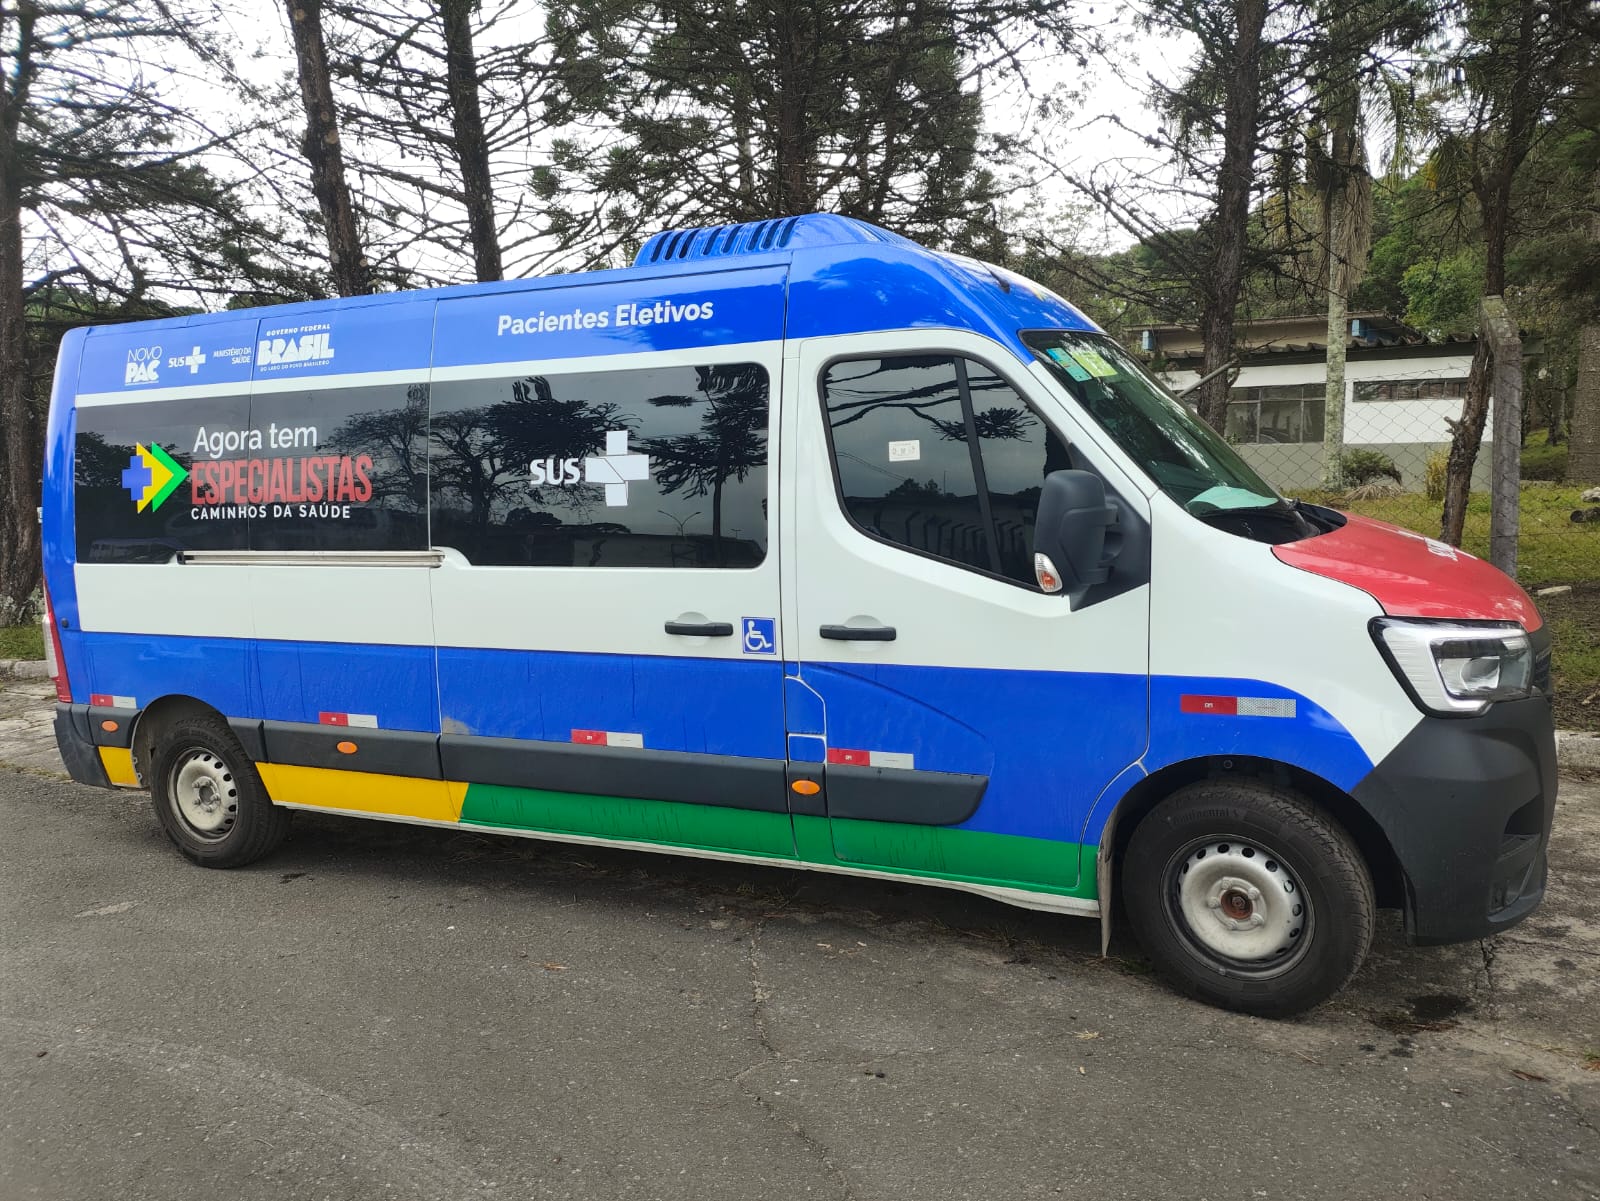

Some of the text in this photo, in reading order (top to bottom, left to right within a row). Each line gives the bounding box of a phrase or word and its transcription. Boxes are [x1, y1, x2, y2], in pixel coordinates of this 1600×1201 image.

[266, 323, 331, 337] GOVERNO FEDERAL
[497, 300, 714, 336] Pacientes Eletivos
[127, 345, 162, 362] NOVO
[168, 356, 185, 368] SUS
[231, 355, 251, 365] SAÚDE
[257, 333, 335, 366] BRASIL
[125, 359, 160, 384] PAC
[193, 423, 318, 459] Agora tem
[191, 454, 373, 506] ESPECIALISTAS
[529, 457, 580, 485] SUS
[191, 502, 351, 520] CAMINHOS DA SAÚDE
